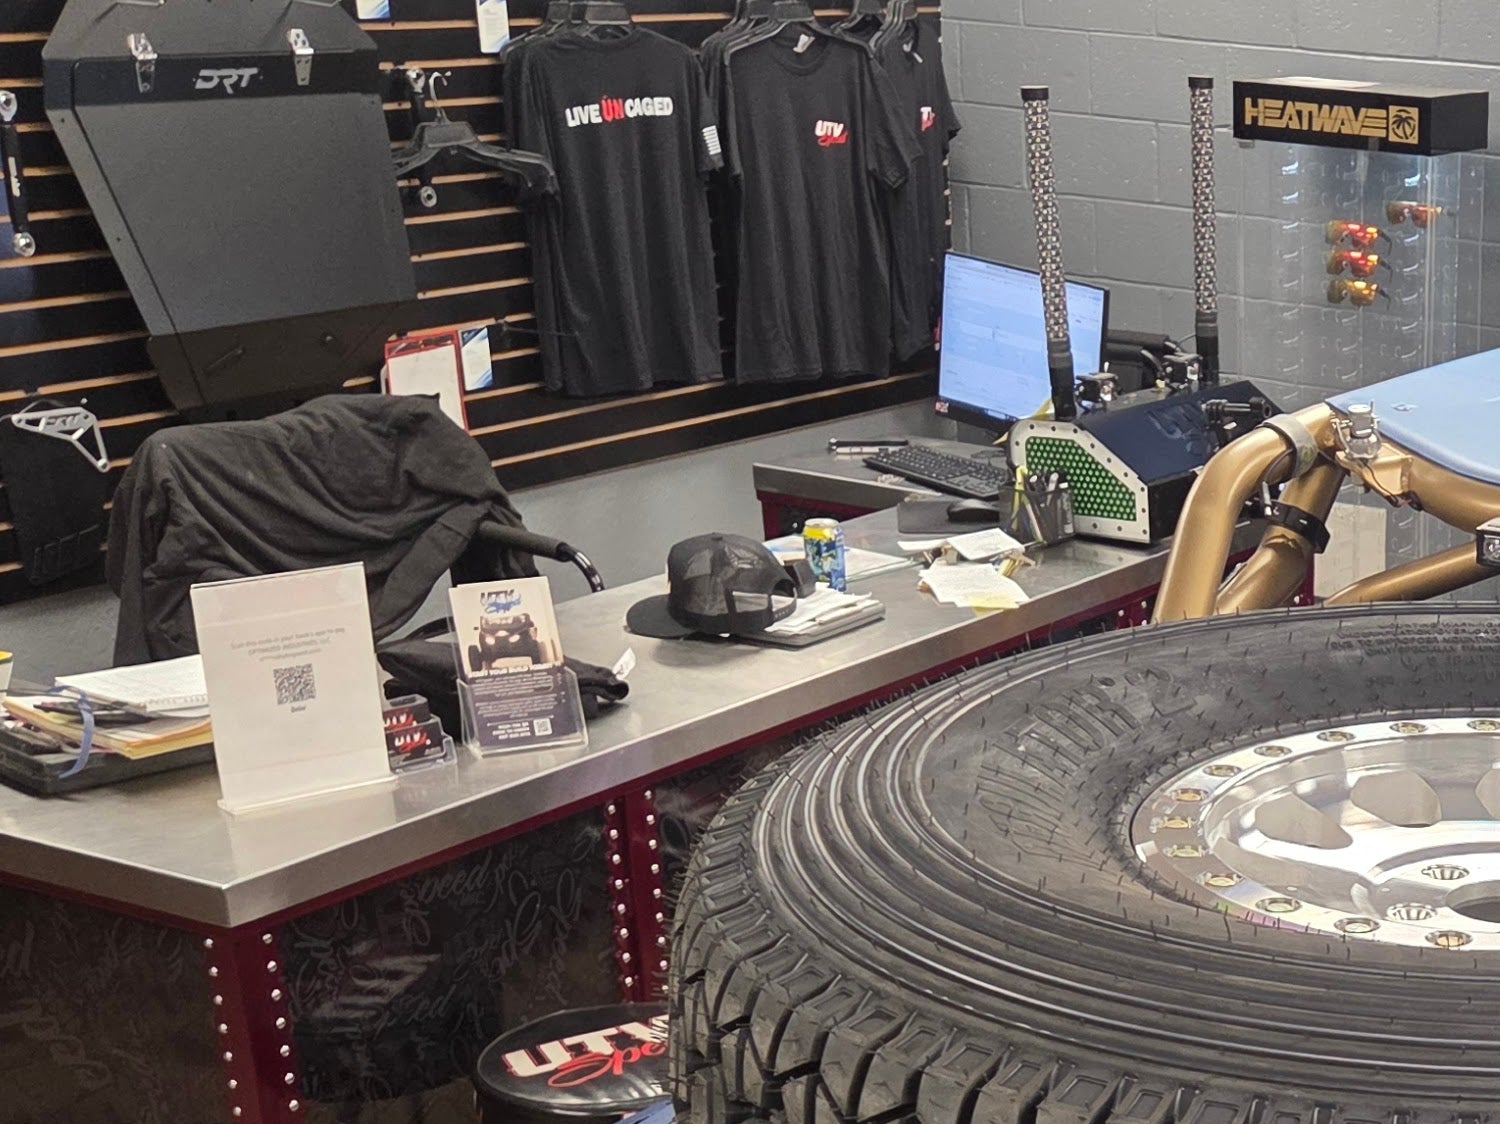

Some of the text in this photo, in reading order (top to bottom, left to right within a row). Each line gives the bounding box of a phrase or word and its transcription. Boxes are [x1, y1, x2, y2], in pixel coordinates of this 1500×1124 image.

[195, 67, 259, 94] DRT
[565, 103, 603, 127] LIVE
[1245, 97, 1388, 138] HEATWAVE
[815, 119, 844, 137] UTV
[394, 731, 420, 747] UTV
